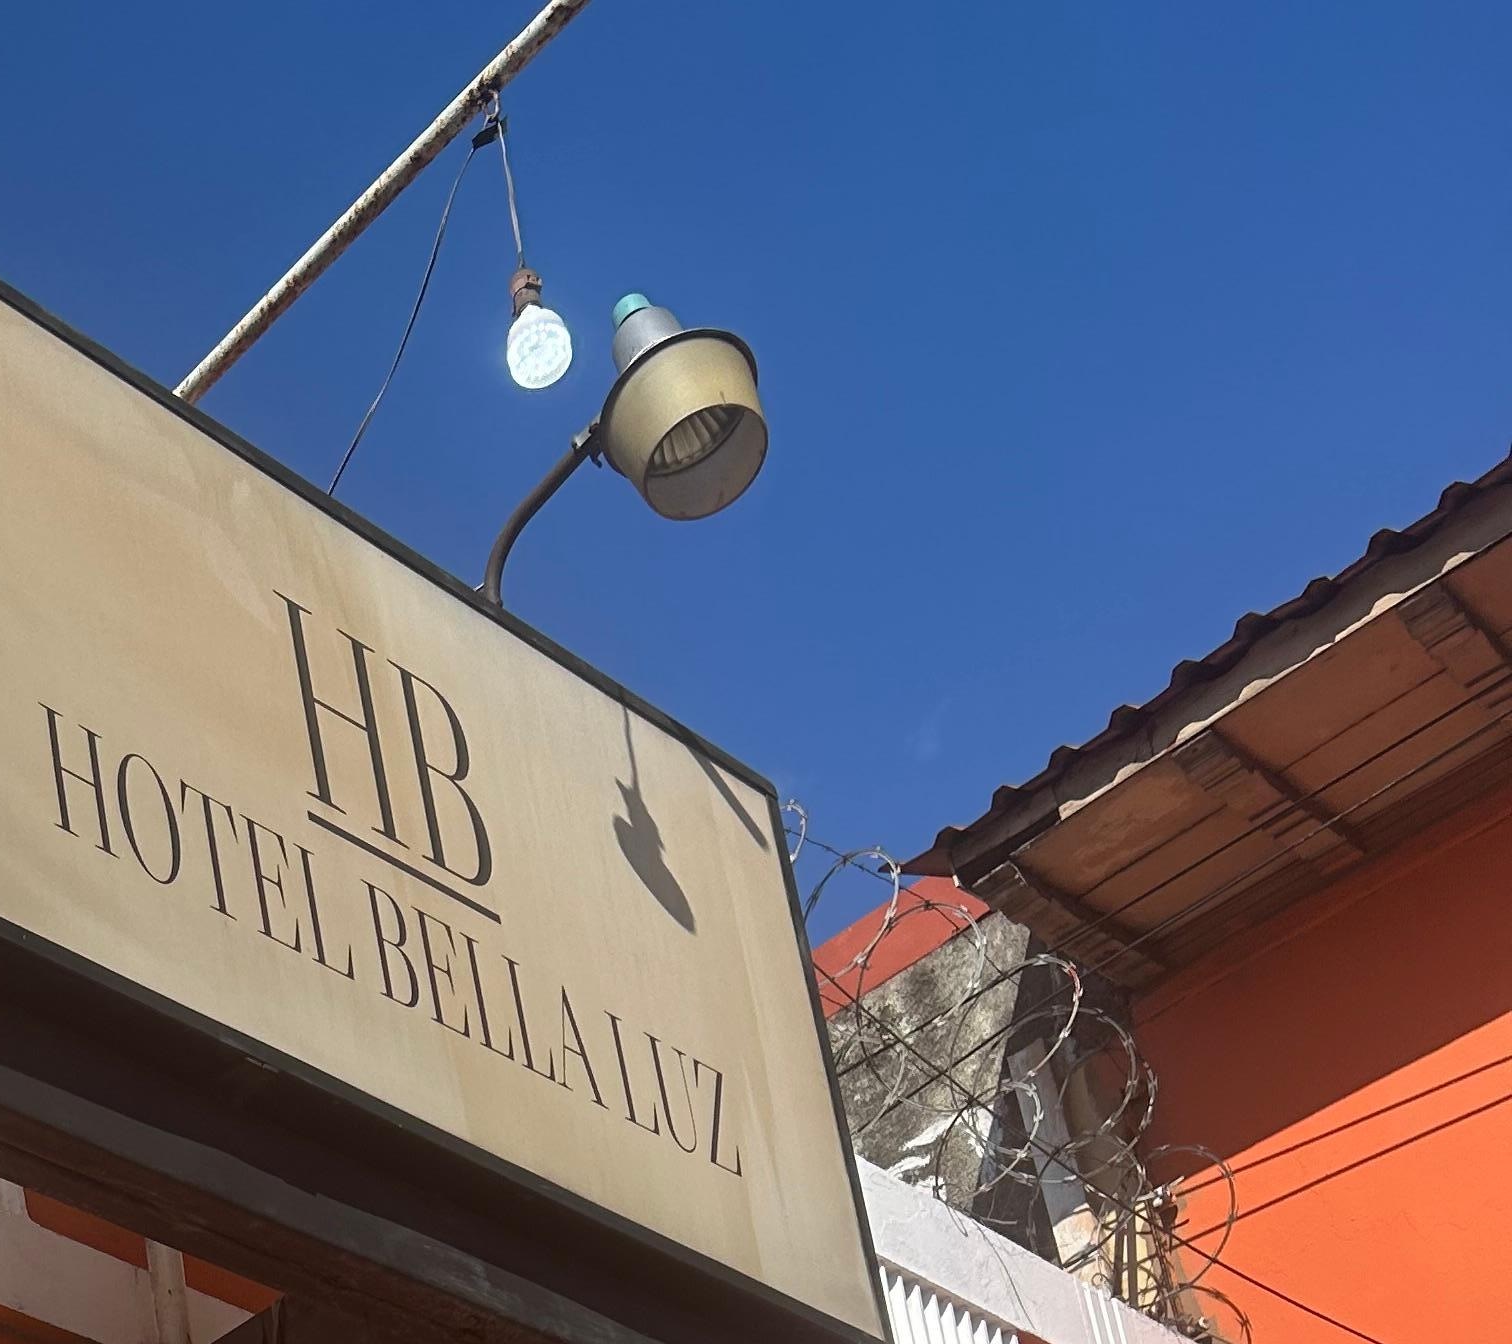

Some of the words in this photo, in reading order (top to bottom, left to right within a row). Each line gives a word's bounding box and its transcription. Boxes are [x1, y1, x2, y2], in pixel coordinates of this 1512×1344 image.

[272, 588, 493, 887] HB
[38, 701, 356, 981] HOTEL
[360, 878, 609, 1109] BELLA
[603, 1009, 743, 1178] LUZ
